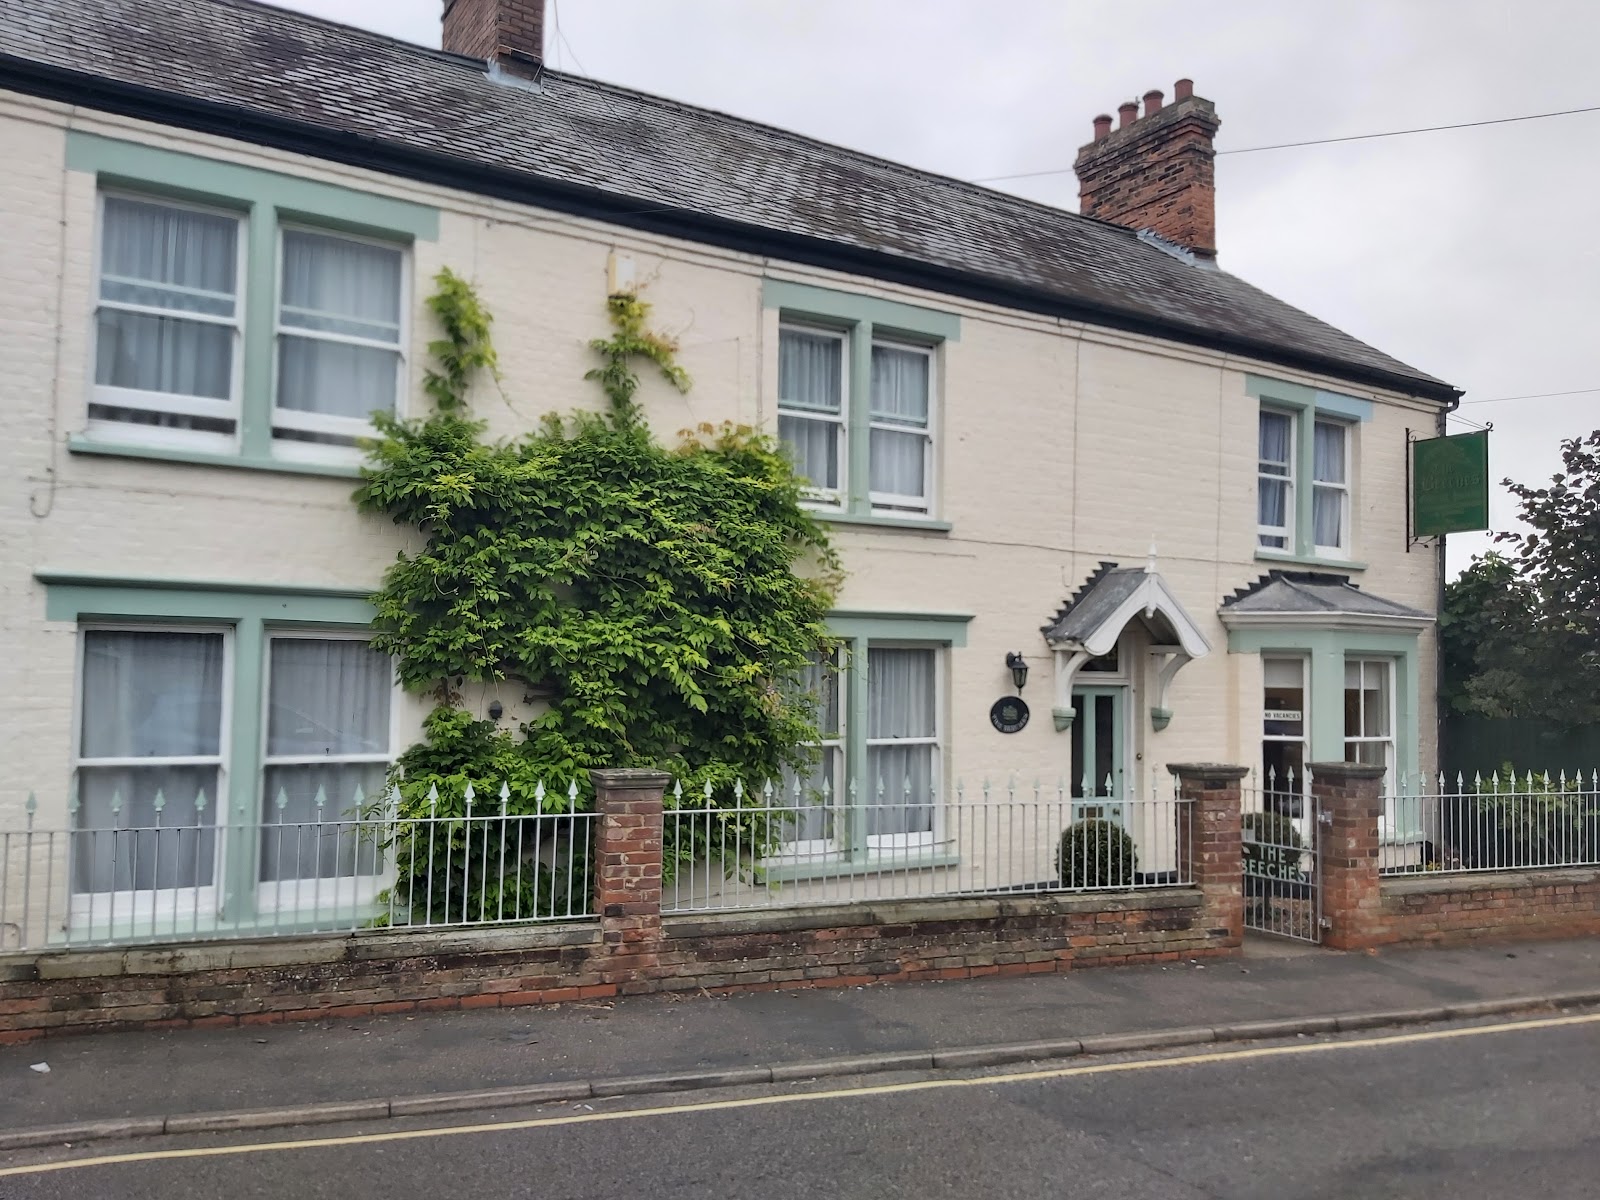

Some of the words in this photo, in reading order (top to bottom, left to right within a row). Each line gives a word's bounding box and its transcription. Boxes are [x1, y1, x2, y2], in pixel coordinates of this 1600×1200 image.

[1273, 712, 1300, 720] VACANCIES
[1257, 844, 1286, 863] THE
[1241, 858, 1306, 884] BEECHES
